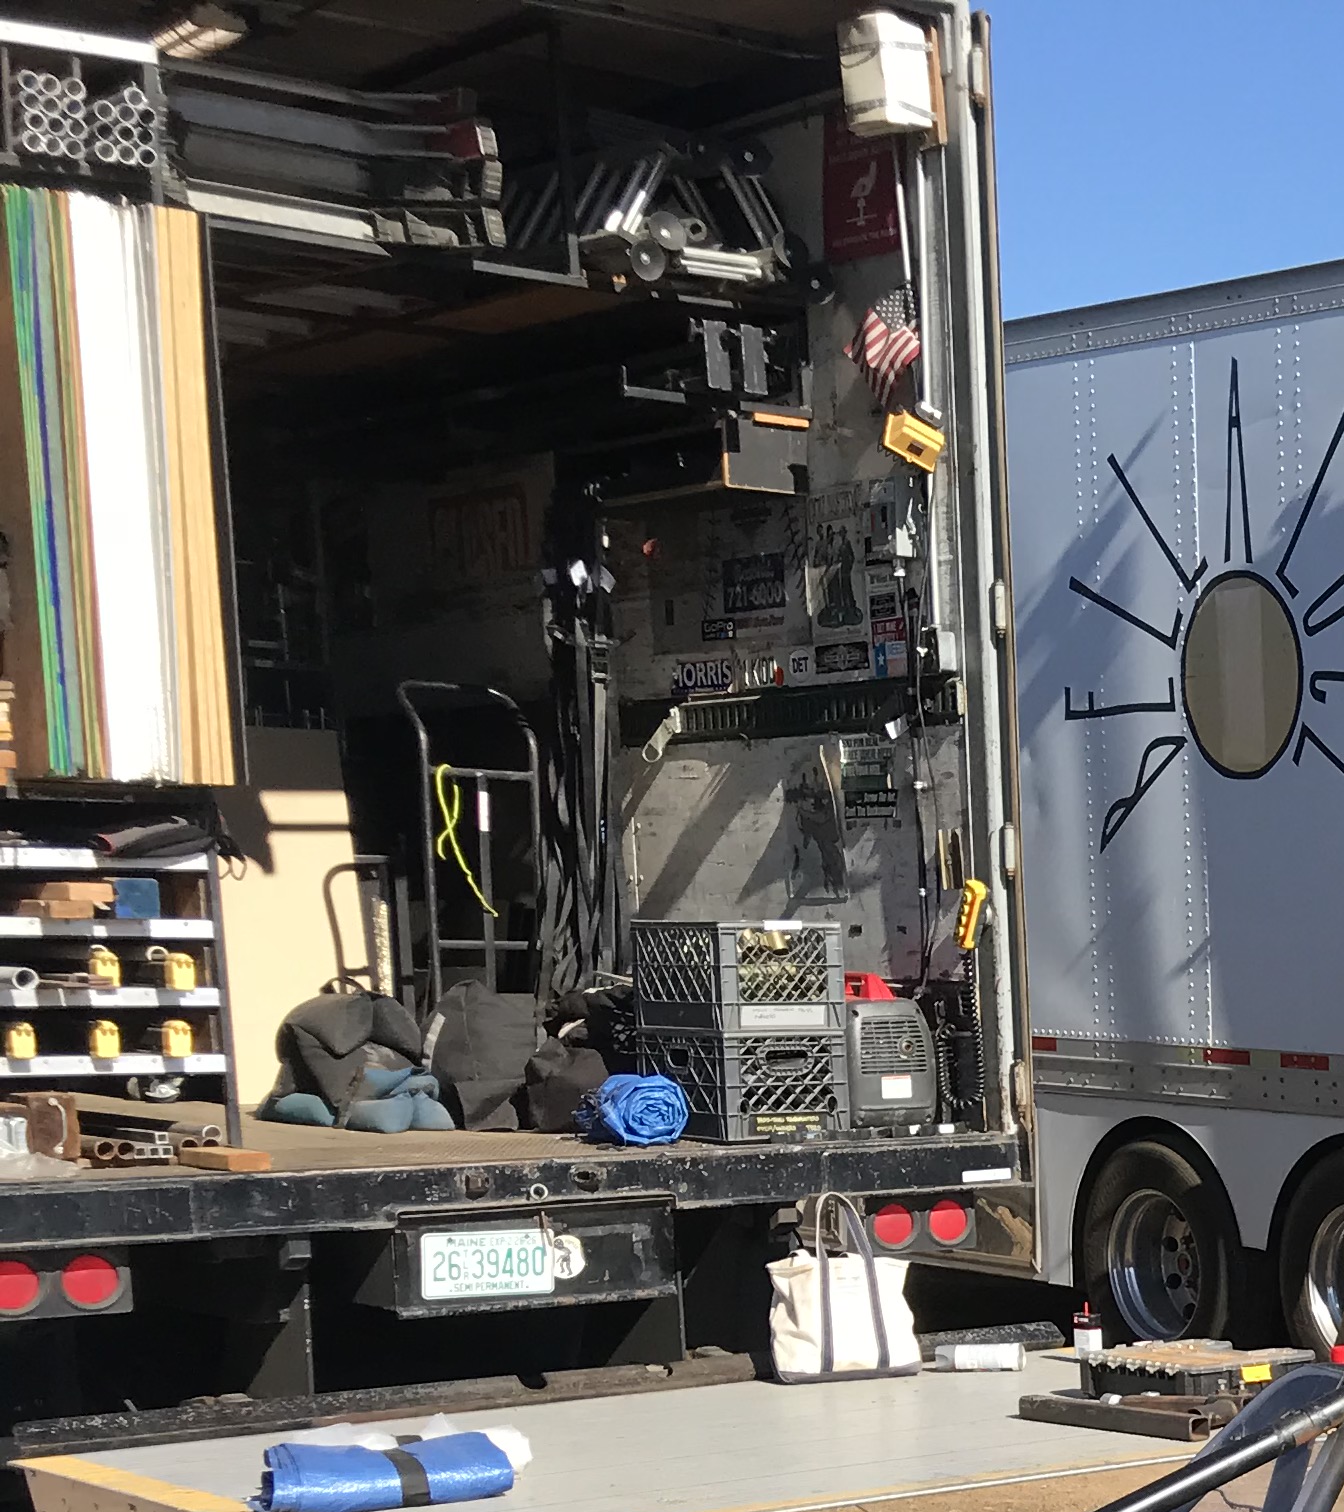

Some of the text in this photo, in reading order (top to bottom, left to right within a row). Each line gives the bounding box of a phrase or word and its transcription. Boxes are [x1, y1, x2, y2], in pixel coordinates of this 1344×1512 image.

[791, 657, 808, 673] DET
[446, 1237, 485, 1247] MAINE
[433, 1248, 461, 1282] 26
[472, 1246, 545, 1279] 39480
[475, 1279, 525, 1291] PERMANENT
